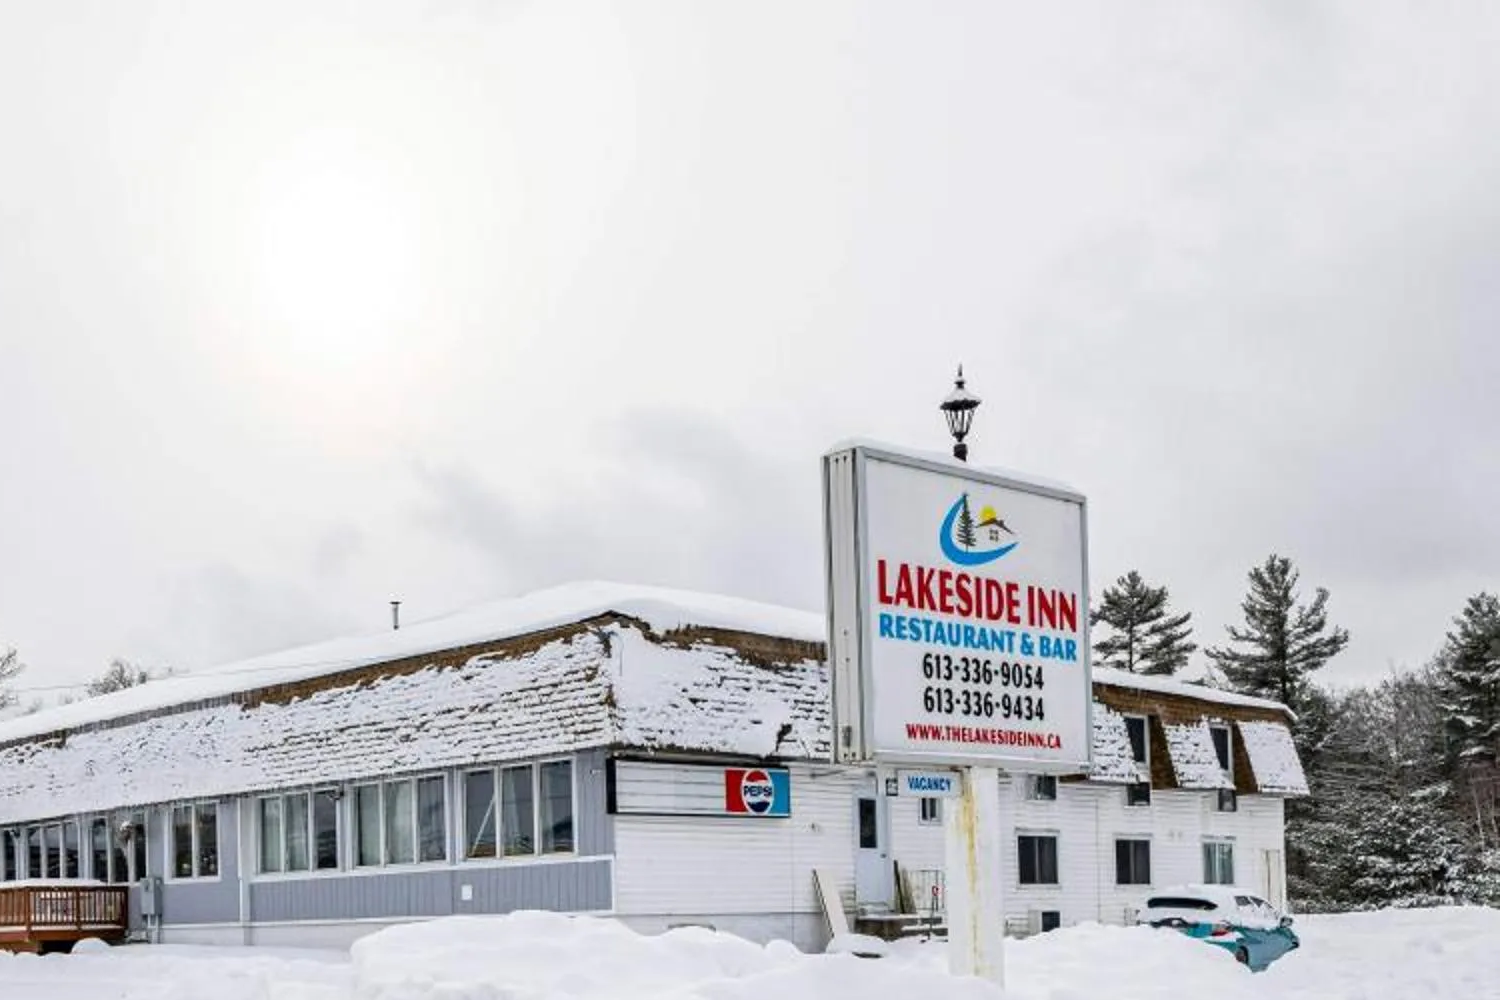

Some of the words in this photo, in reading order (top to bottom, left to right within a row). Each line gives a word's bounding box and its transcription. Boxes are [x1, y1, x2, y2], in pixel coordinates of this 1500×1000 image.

[877, 559, 1021, 625] LAKESIDE
[1027, 585, 1077, 633] INN
[879, 612, 1017, 654] RESTAURANT
[1020, 631, 1035, 656] &
[1039, 635, 1077, 662] BAR
[905, 723, 1062, 749] WWW.THELAKESIDEINN.CA
[743, 785, 773, 797] PEPSI
[907, 775, 951, 792] VACANCY
